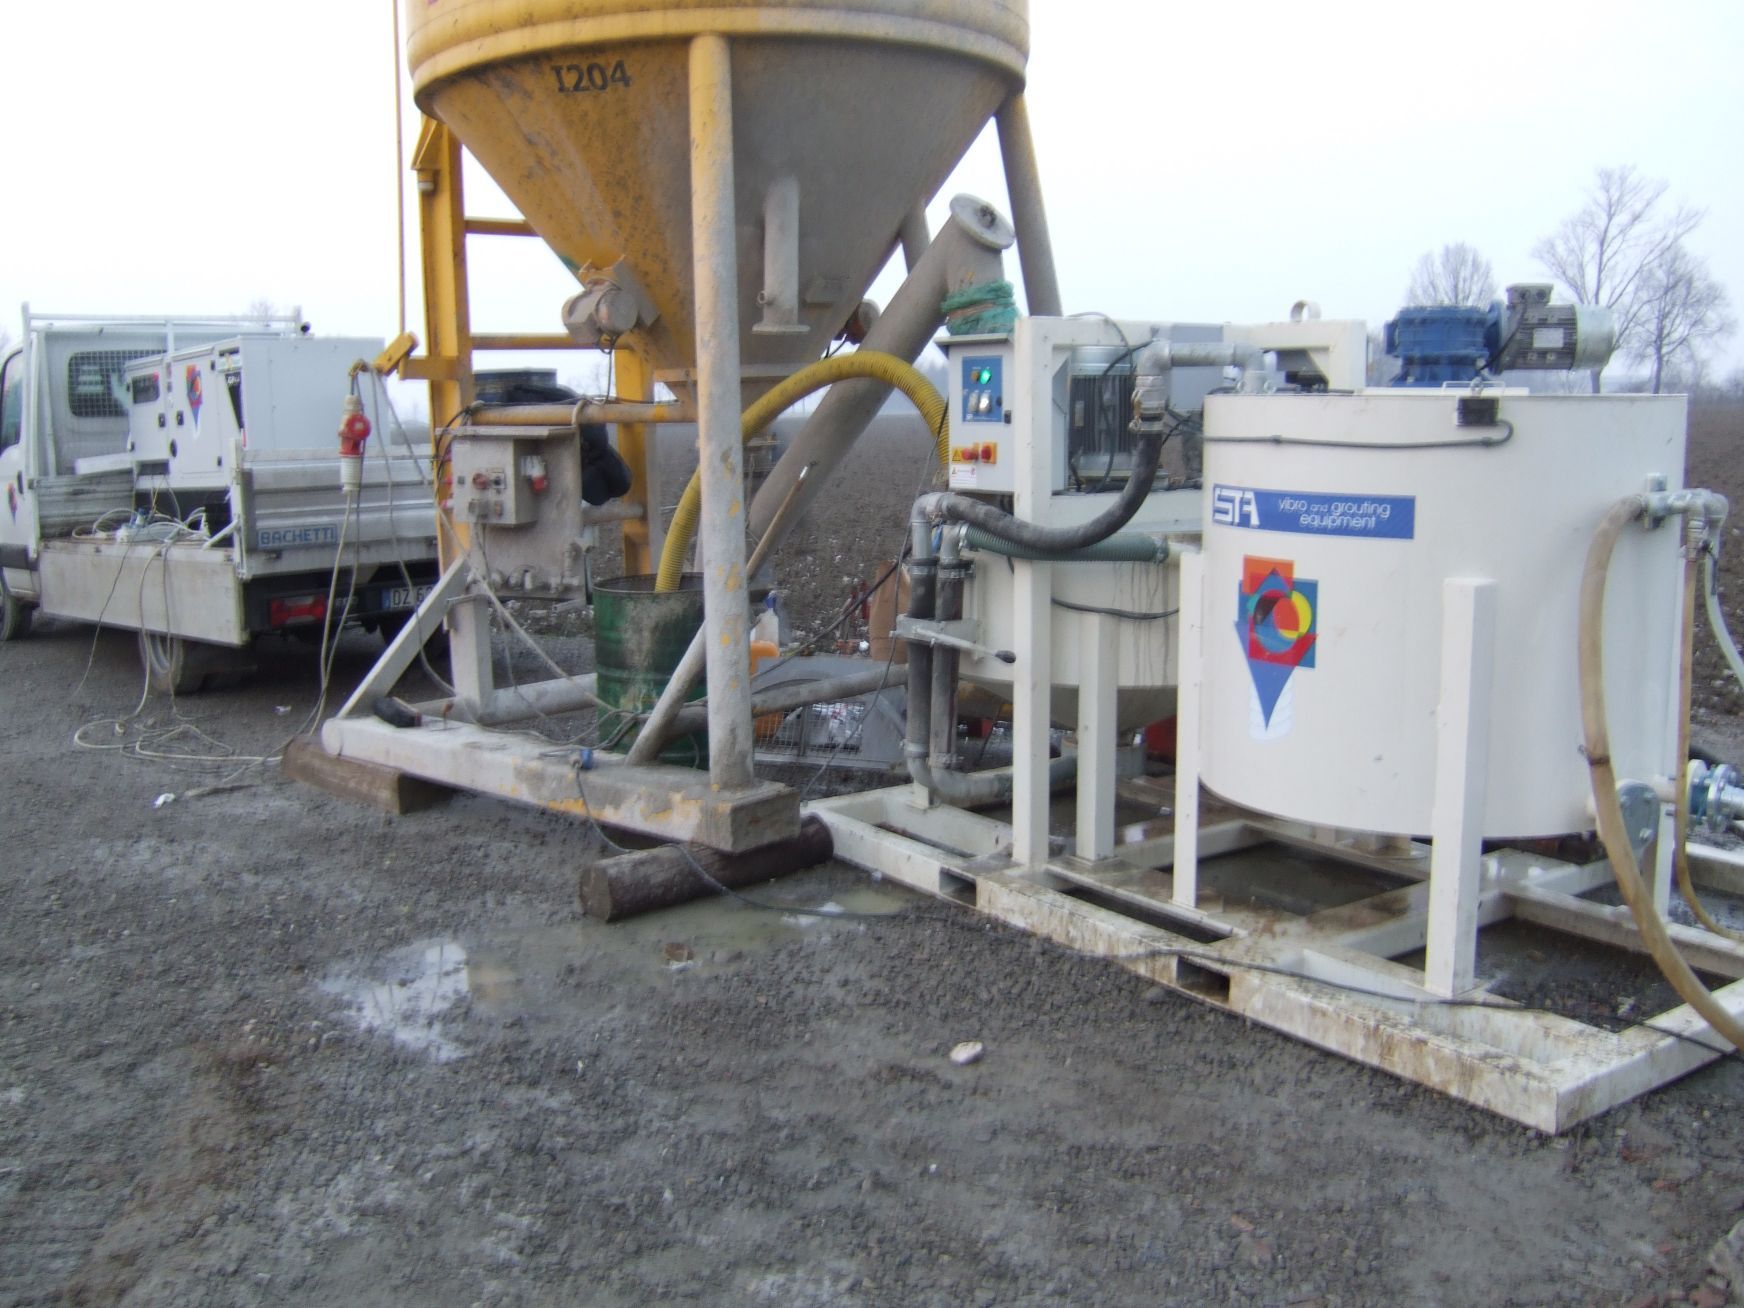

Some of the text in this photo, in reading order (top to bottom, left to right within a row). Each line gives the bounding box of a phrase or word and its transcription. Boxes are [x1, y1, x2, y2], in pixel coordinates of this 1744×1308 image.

[1213, 487, 1260, 527] STA
[1278, 496, 1391, 518] vibro and grouting
[1299, 512, 1376, 529] equipment
[260, 528, 335, 546] BACHETTI
[393, 589, 410, 606] DZ
